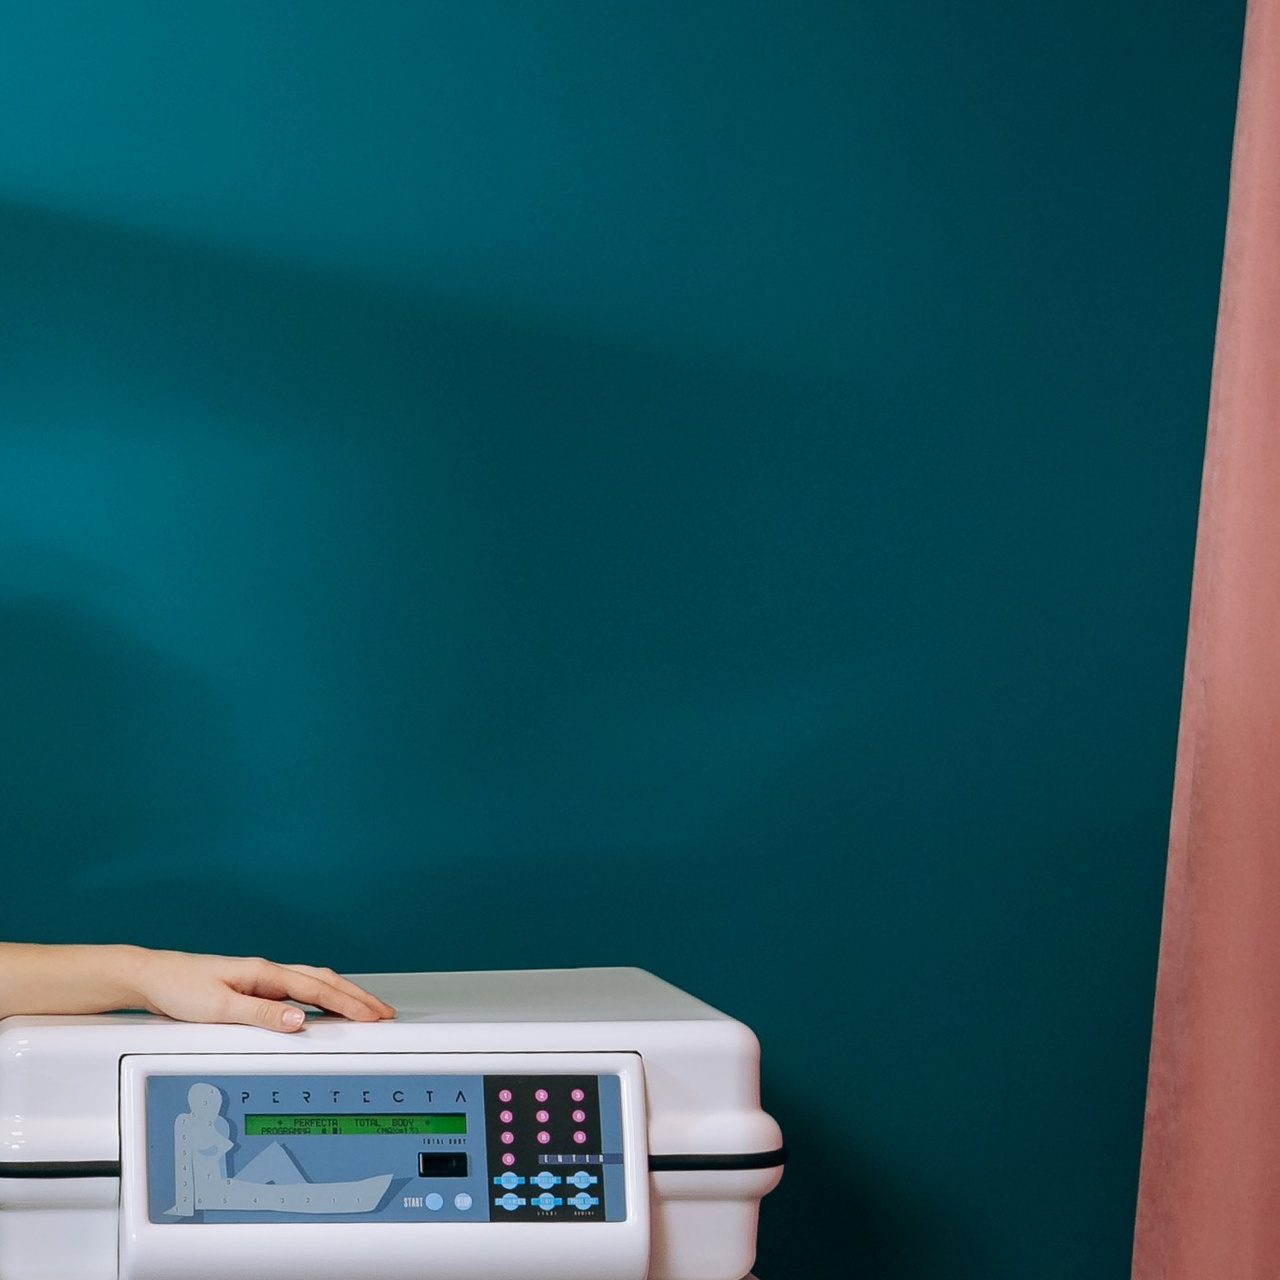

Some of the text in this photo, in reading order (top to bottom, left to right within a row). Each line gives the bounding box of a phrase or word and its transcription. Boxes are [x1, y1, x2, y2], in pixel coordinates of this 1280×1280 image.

[241, 1090, 467, 1104] PERFECTA
[293, 1118, 414, 1128] PERFECTA TOTAL BODY
[261, 1127, 311, 1135] PROGRAMMA
[544, 1154, 604, 1163] ENTER
[403, 1197, 423, 1208] START
